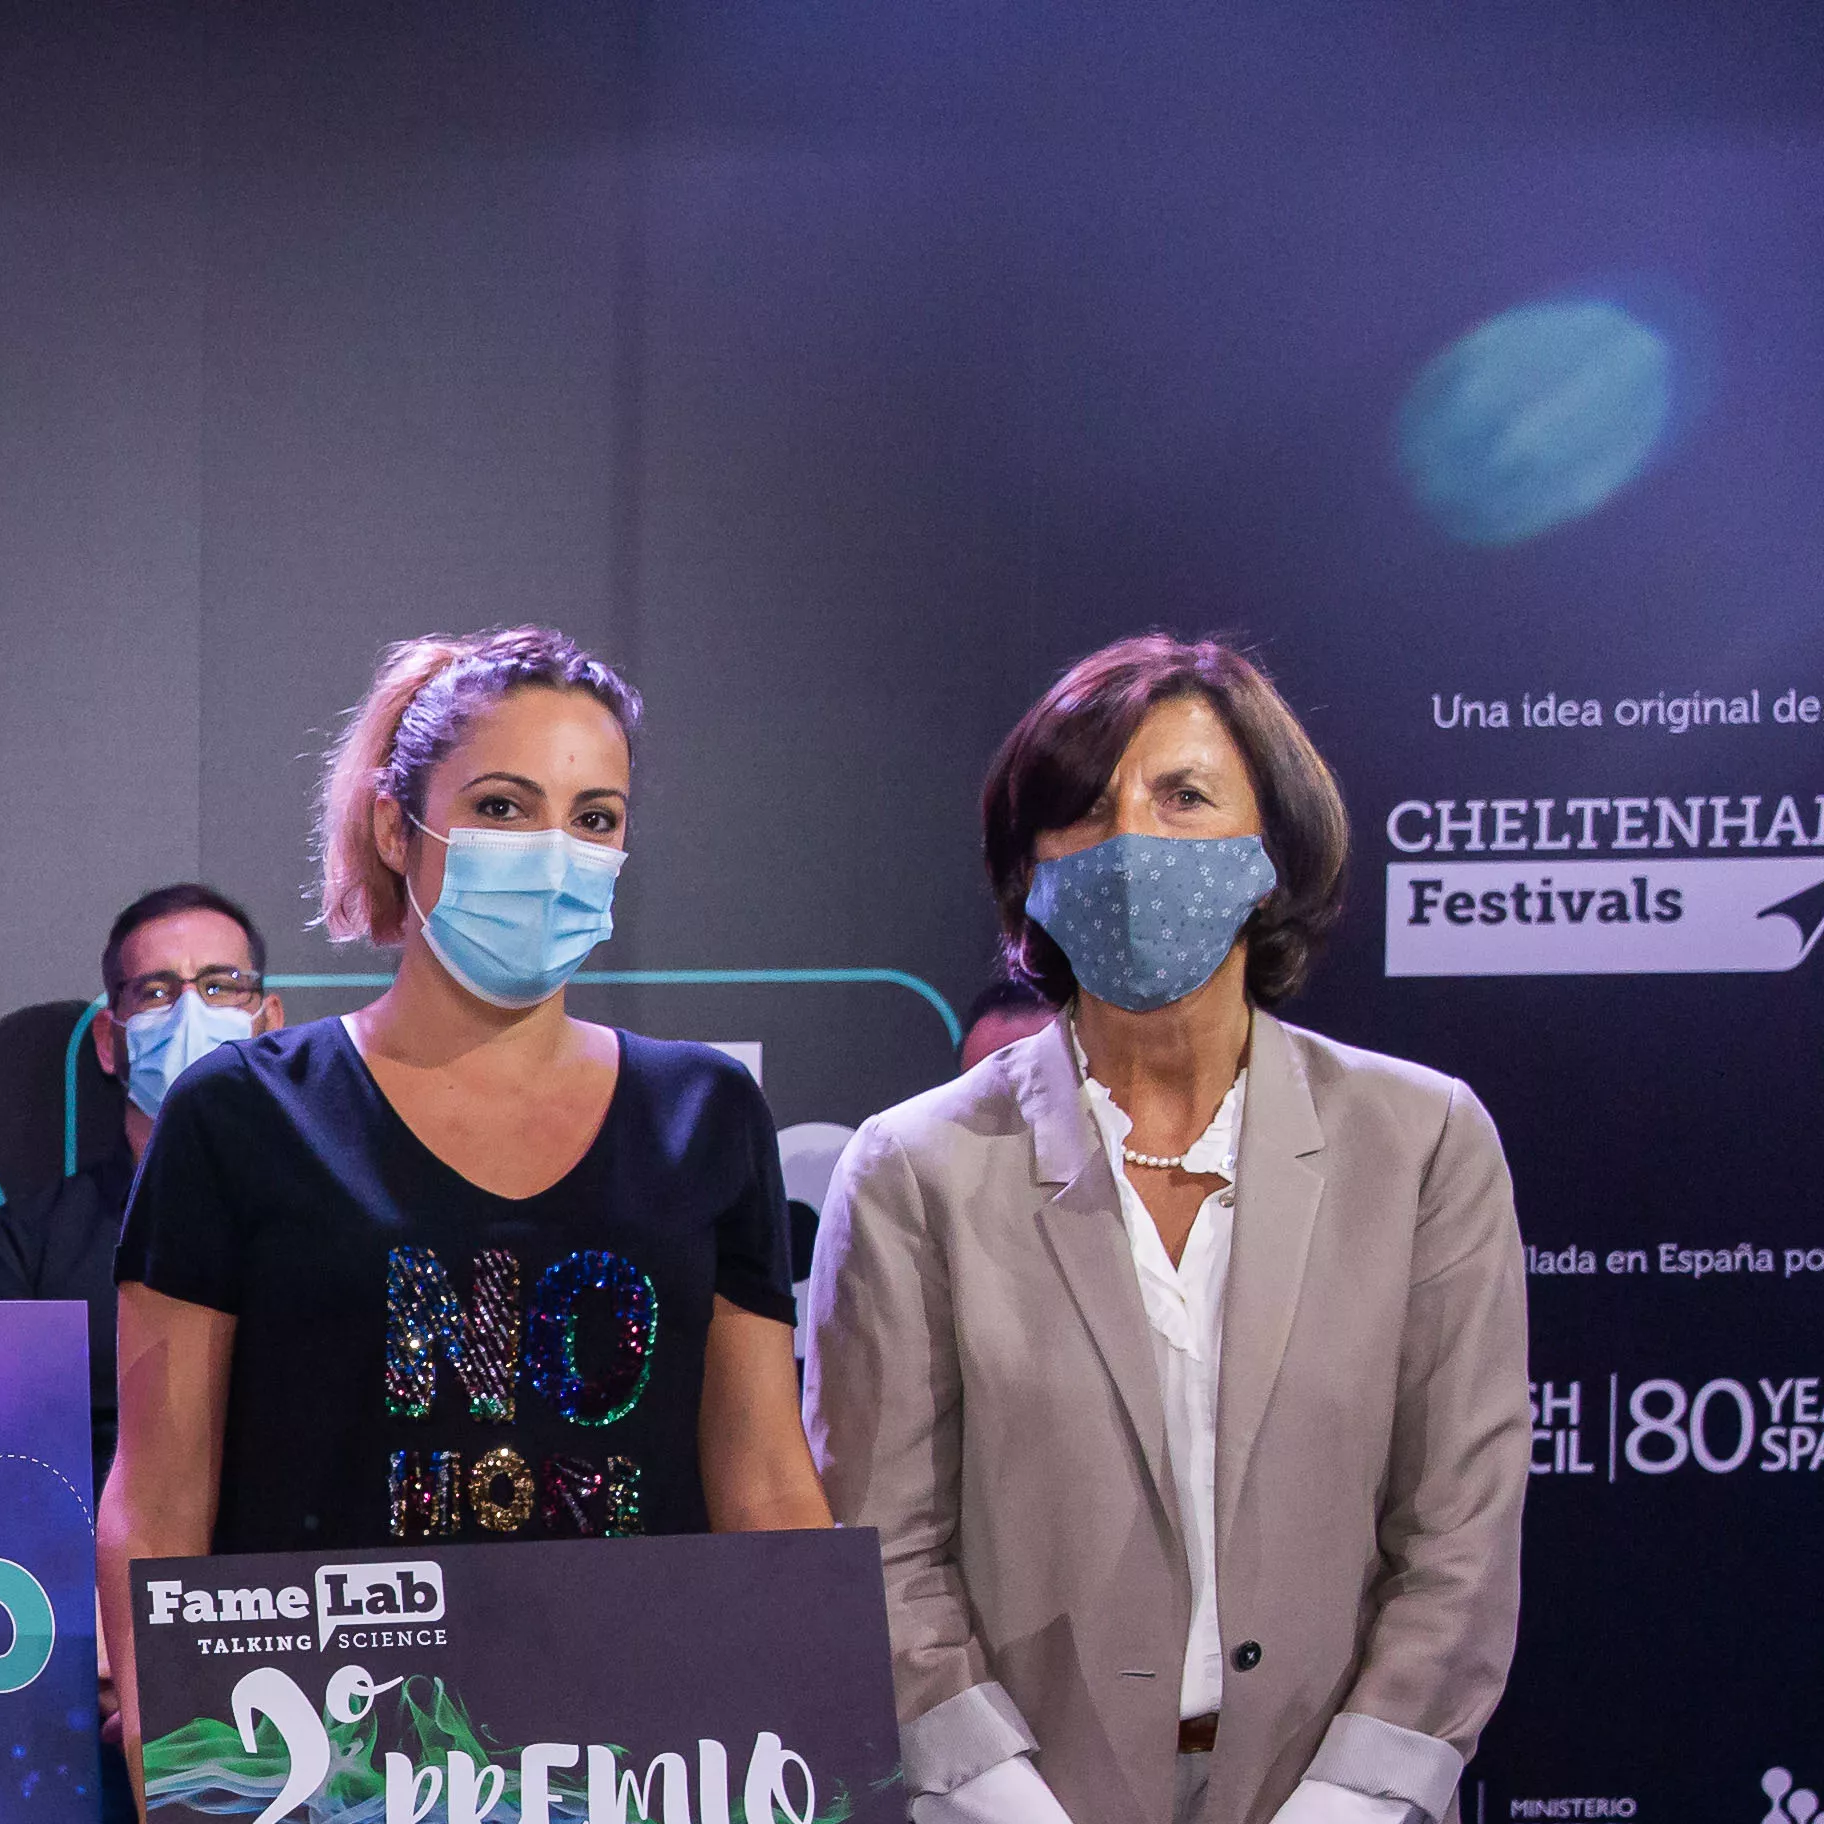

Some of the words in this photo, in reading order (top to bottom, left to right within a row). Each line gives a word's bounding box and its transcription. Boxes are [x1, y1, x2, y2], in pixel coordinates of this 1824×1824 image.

[1432, 694, 1509, 729] Una
[1523, 692, 1602, 727] idea
[1614, 688, 1760, 734] original
[1386, 796, 1824, 852] CHELTENHA
[1407, 877, 1683, 926] Festivals
[1606, 1249, 1649, 1273] en
[1658, 1243, 1774, 1279] España
[385, 1245, 658, 1428] NO
[1624, 1378, 1755, 1474] 80
[147, 1580, 309, 1624] Fame
[325, 1571, 438, 1616] Lab
[198, 1635, 312, 1654] TALKING
[338, 1629, 448, 1649] SCIENCE
[1510, 1797, 1637, 1818] MINISTERIO
